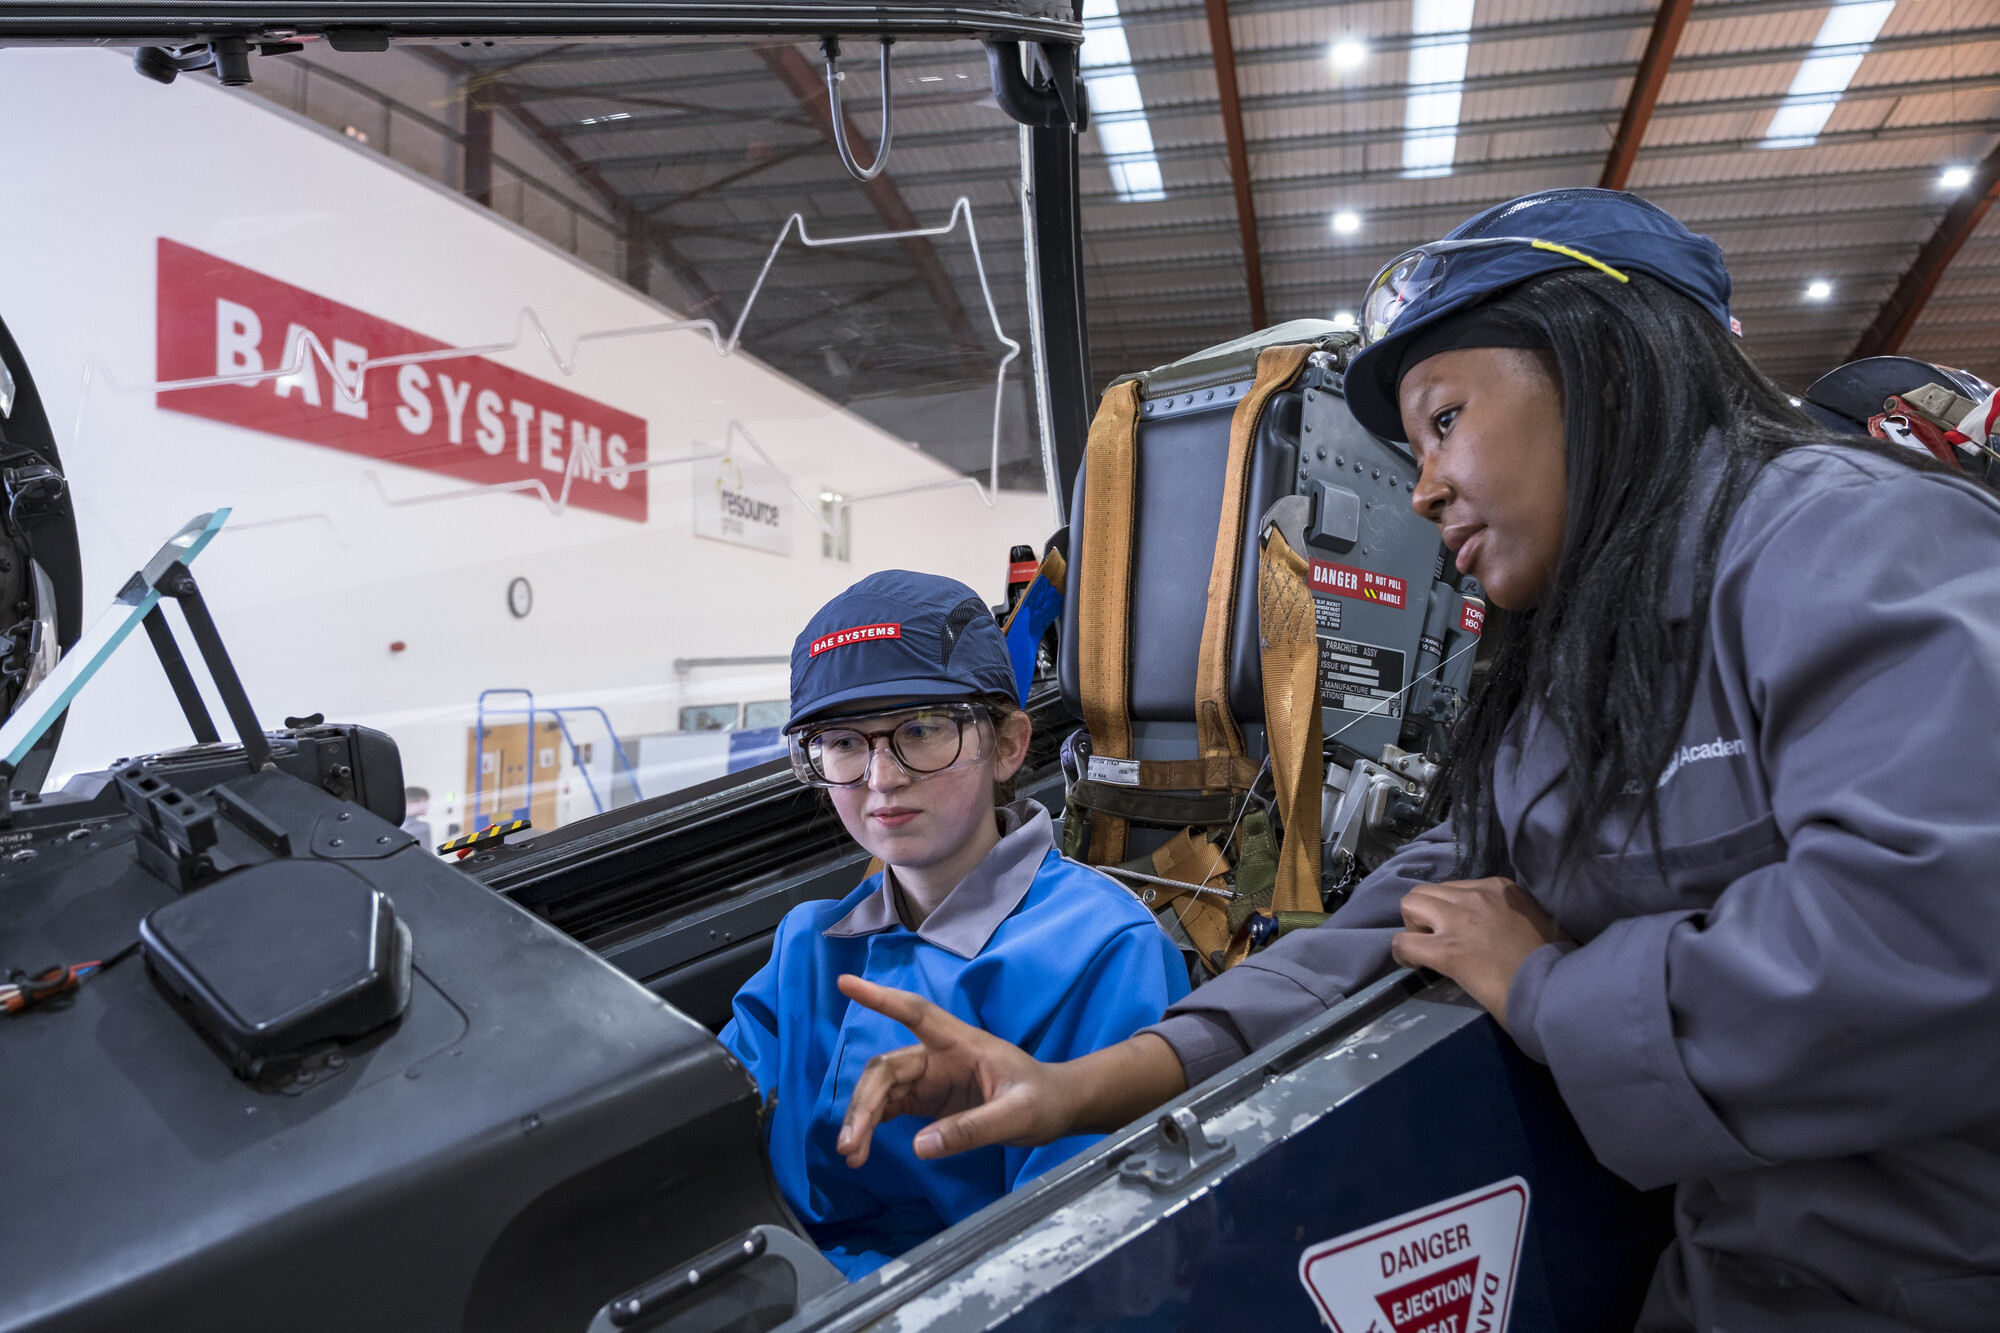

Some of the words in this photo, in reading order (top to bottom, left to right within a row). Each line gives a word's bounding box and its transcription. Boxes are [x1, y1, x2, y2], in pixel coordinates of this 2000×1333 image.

[217, 298, 368, 420] BAE
[396, 363, 630, 491] SYSTEMS
[721, 489, 779, 527] resource
[1313, 565, 1358, 590] DANGER
[1364, 572, 1372, 582] DO
[1375, 575, 1386, 586] NOT
[1388, 578, 1402, 590] PULL
[1379, 591, 1400, 604] HANDLE
[814, 637, 834, 652] BAE
[837, 626, 896, 643] SYSTEMS
[1325, 640, 1358, 654] PARACHUTE
[1363, 647, 1378, 657] ASSY
[1320, 660, 1338, 670] ISSUE
[1321, 690, 1344, 700] ATIONS
[1324, 680, 1368, 694] MANUFACTURE
[1380, 1223, 1471, 1279] DANGER
[1391, 1273, 1473, 1326] EJECTION
[1475, 1271, 1500, 1333] DAN
